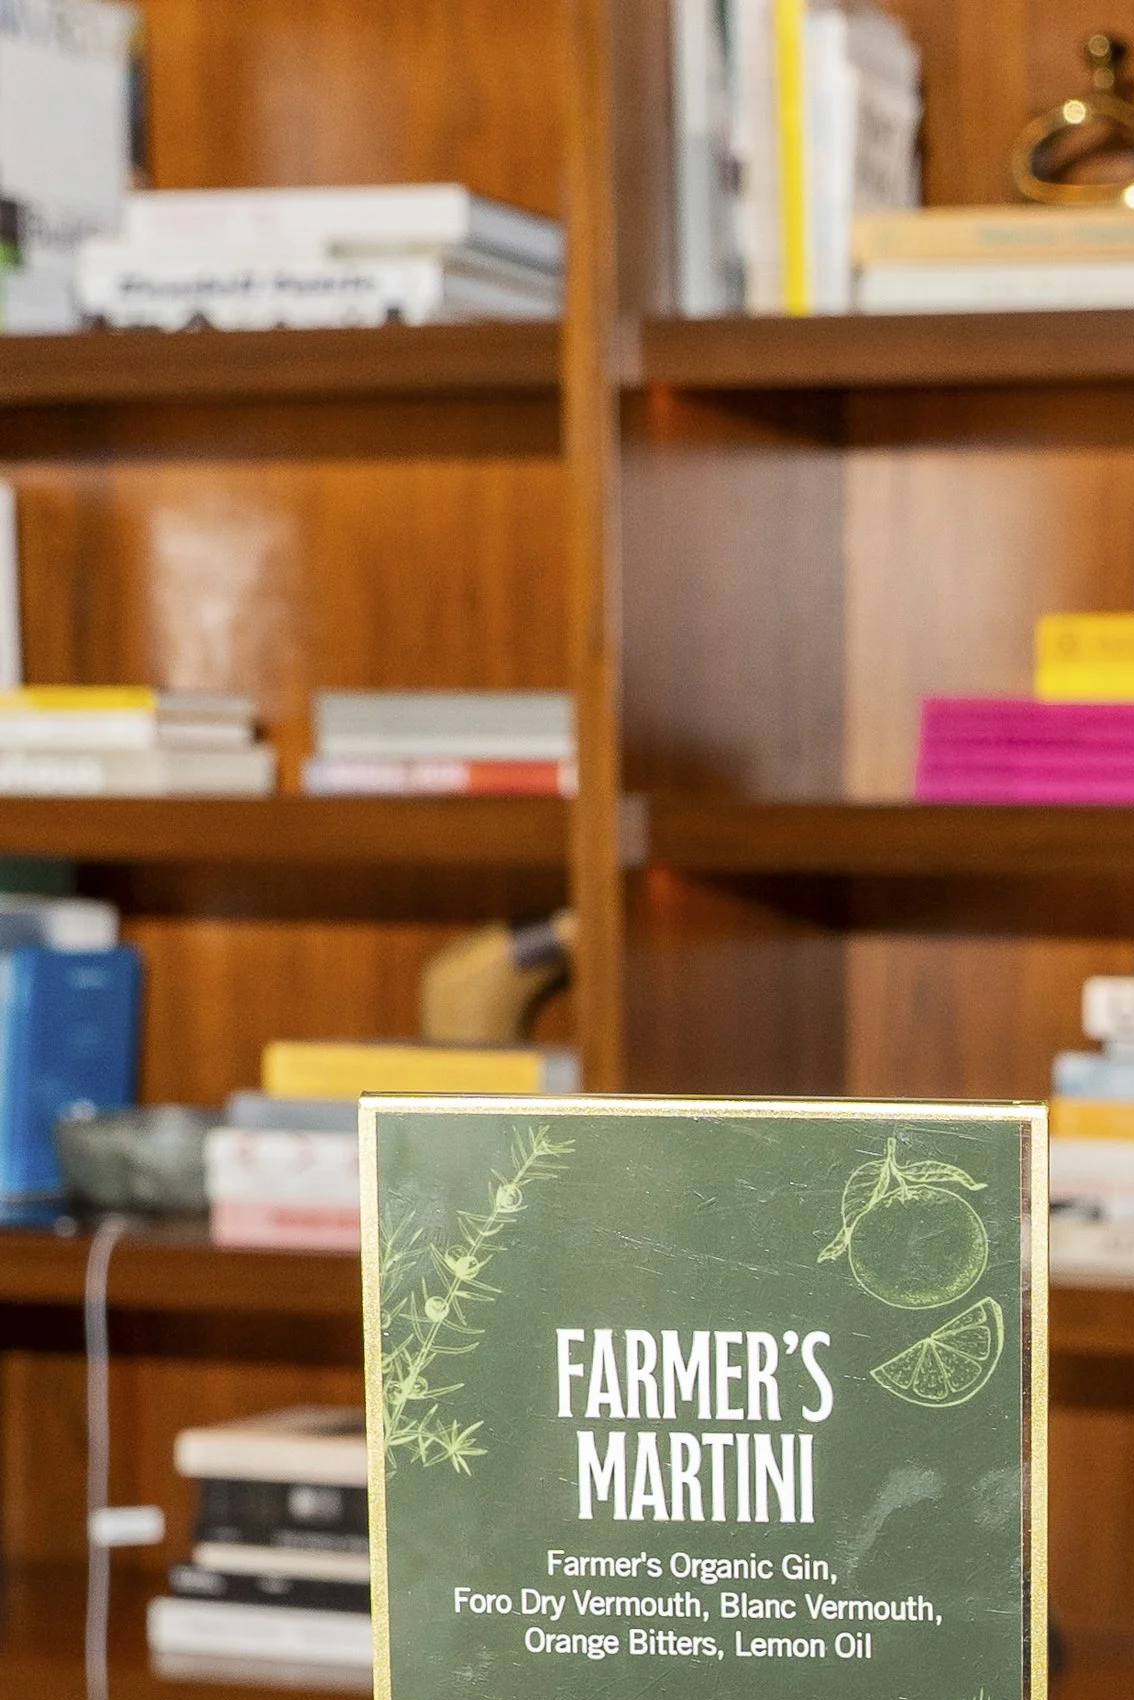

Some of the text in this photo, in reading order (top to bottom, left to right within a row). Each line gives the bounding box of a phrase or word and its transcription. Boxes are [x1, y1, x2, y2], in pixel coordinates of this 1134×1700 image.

[556, 1328, 834, 1423] FARMER'S
[577, 1431, 815, 1524] MARTINI
[547, 1550, 838, 1585] Farmer's Organic Gin,
[454, 1587, 943, 1626] Foro Dry Vermouth, Blanc Vermouth,
[525, 1628, 872, 1660] Orange Bitters, Lemon Oil
